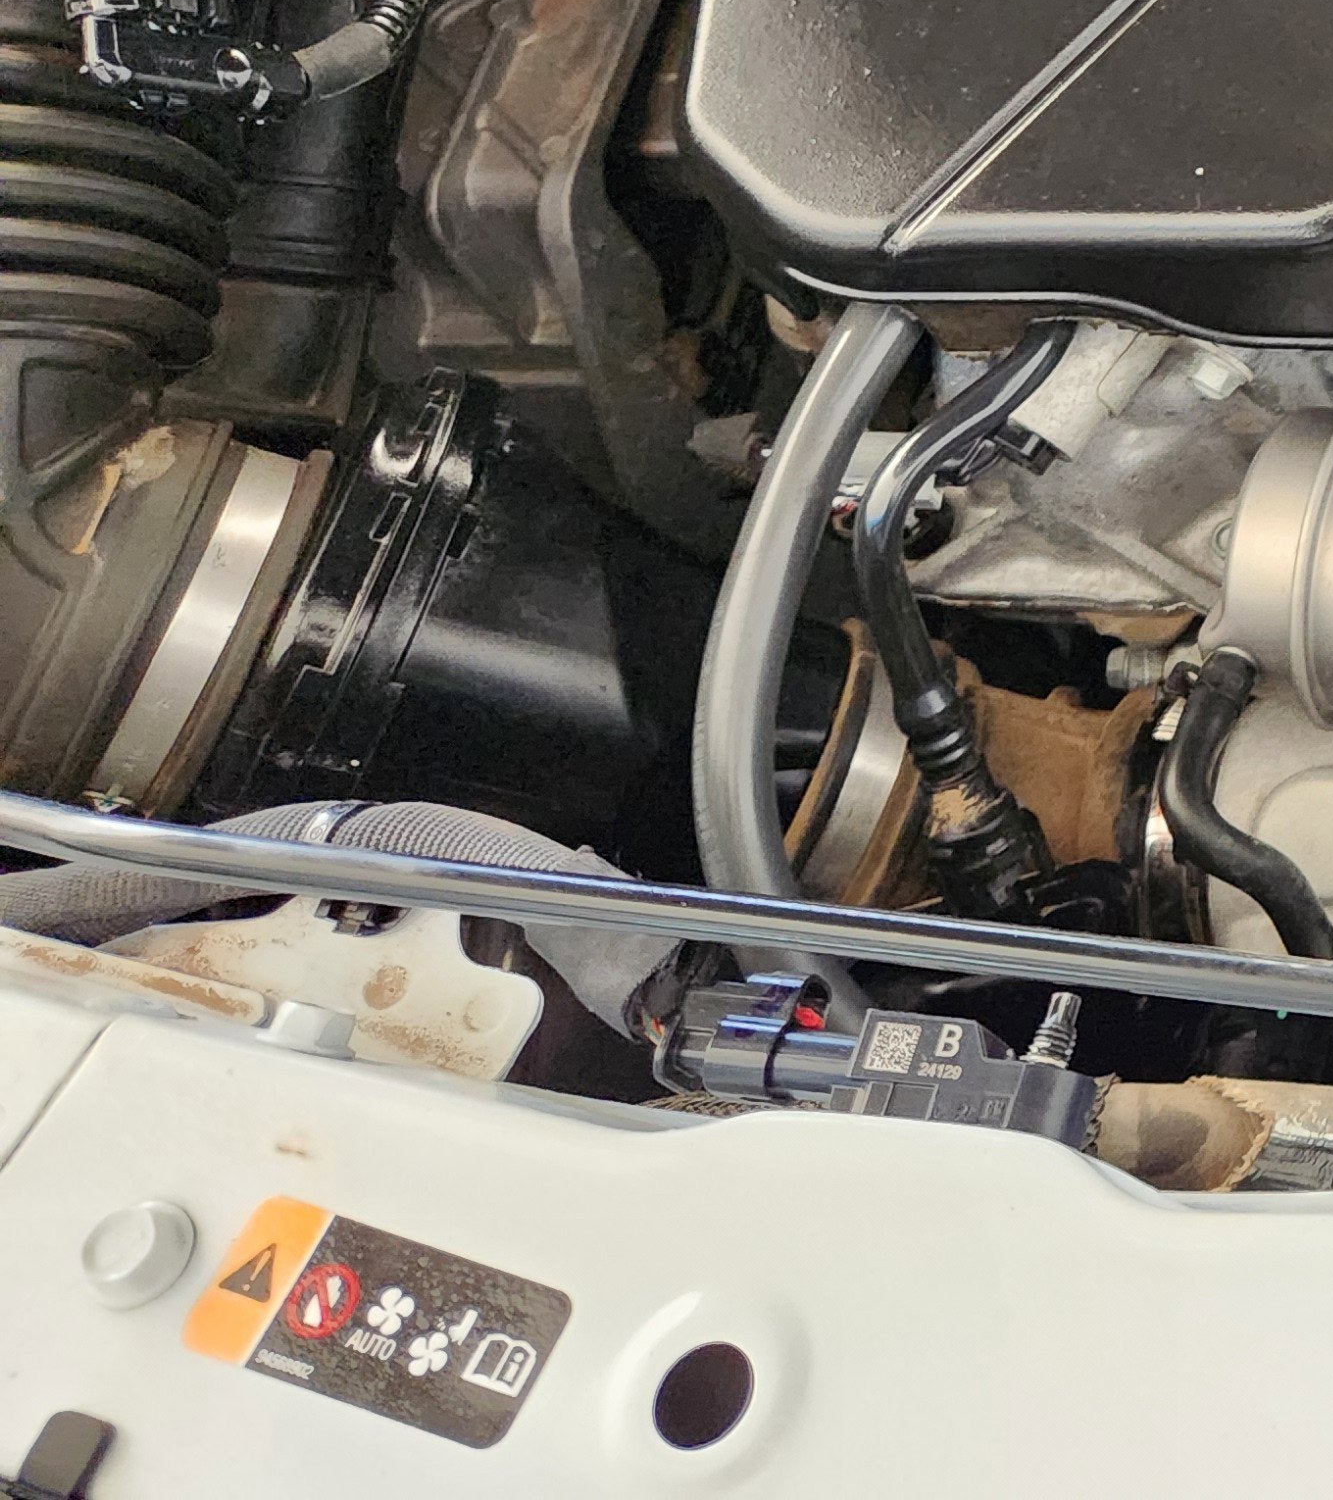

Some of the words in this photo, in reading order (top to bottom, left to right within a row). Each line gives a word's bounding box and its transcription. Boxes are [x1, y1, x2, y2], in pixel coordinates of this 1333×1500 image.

[934, 1023, 963, 1058] B
[917, 1062, 963, 1081] 24129
[344, 1328, 397, 1362] AUTO
